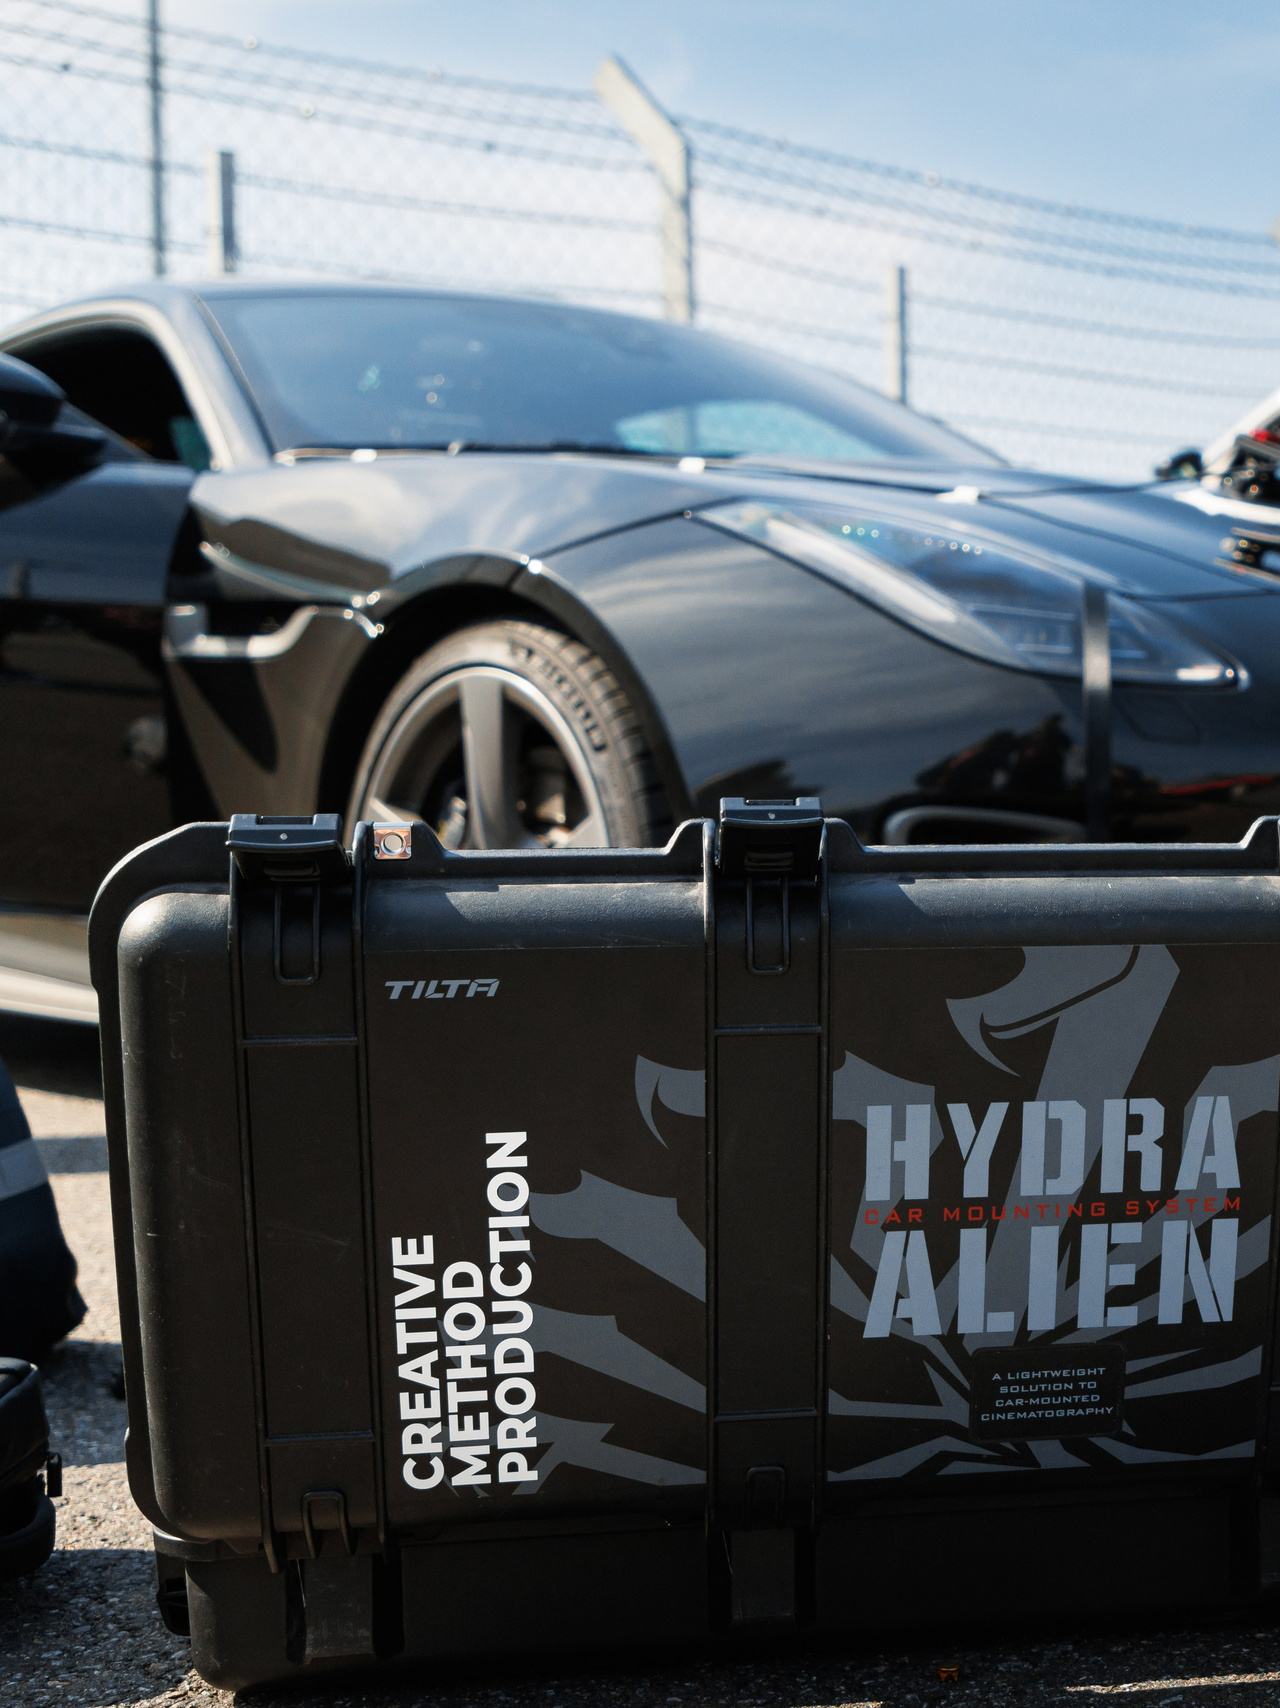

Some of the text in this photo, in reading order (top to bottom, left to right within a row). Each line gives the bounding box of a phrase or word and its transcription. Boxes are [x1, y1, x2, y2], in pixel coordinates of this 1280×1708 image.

[384, 978, 500, 1000] TILTA
[865, 1095, 1241, 1201] HYDRA
[865, 1196, 1241, 1225] CAR MOUNTING SYSTEM
[862, 1218, 1239, 1338] ALIEN
[485, 1131, 538, 1483] PRODUCTION
[391, 1235, 445, 1490] CREATIVE
[442, 1261, 492, 1487] METHOD
[992, 1367, 1106, 1381] A LIGHTWEIGHT
[995, 1394, 1101, 1407] CAR-MOUNTED
[1000, 1381, 1097, 1394] SOLUTION TO
[981, 1406, 1114, 1421] CINEMATOGRAPHY
